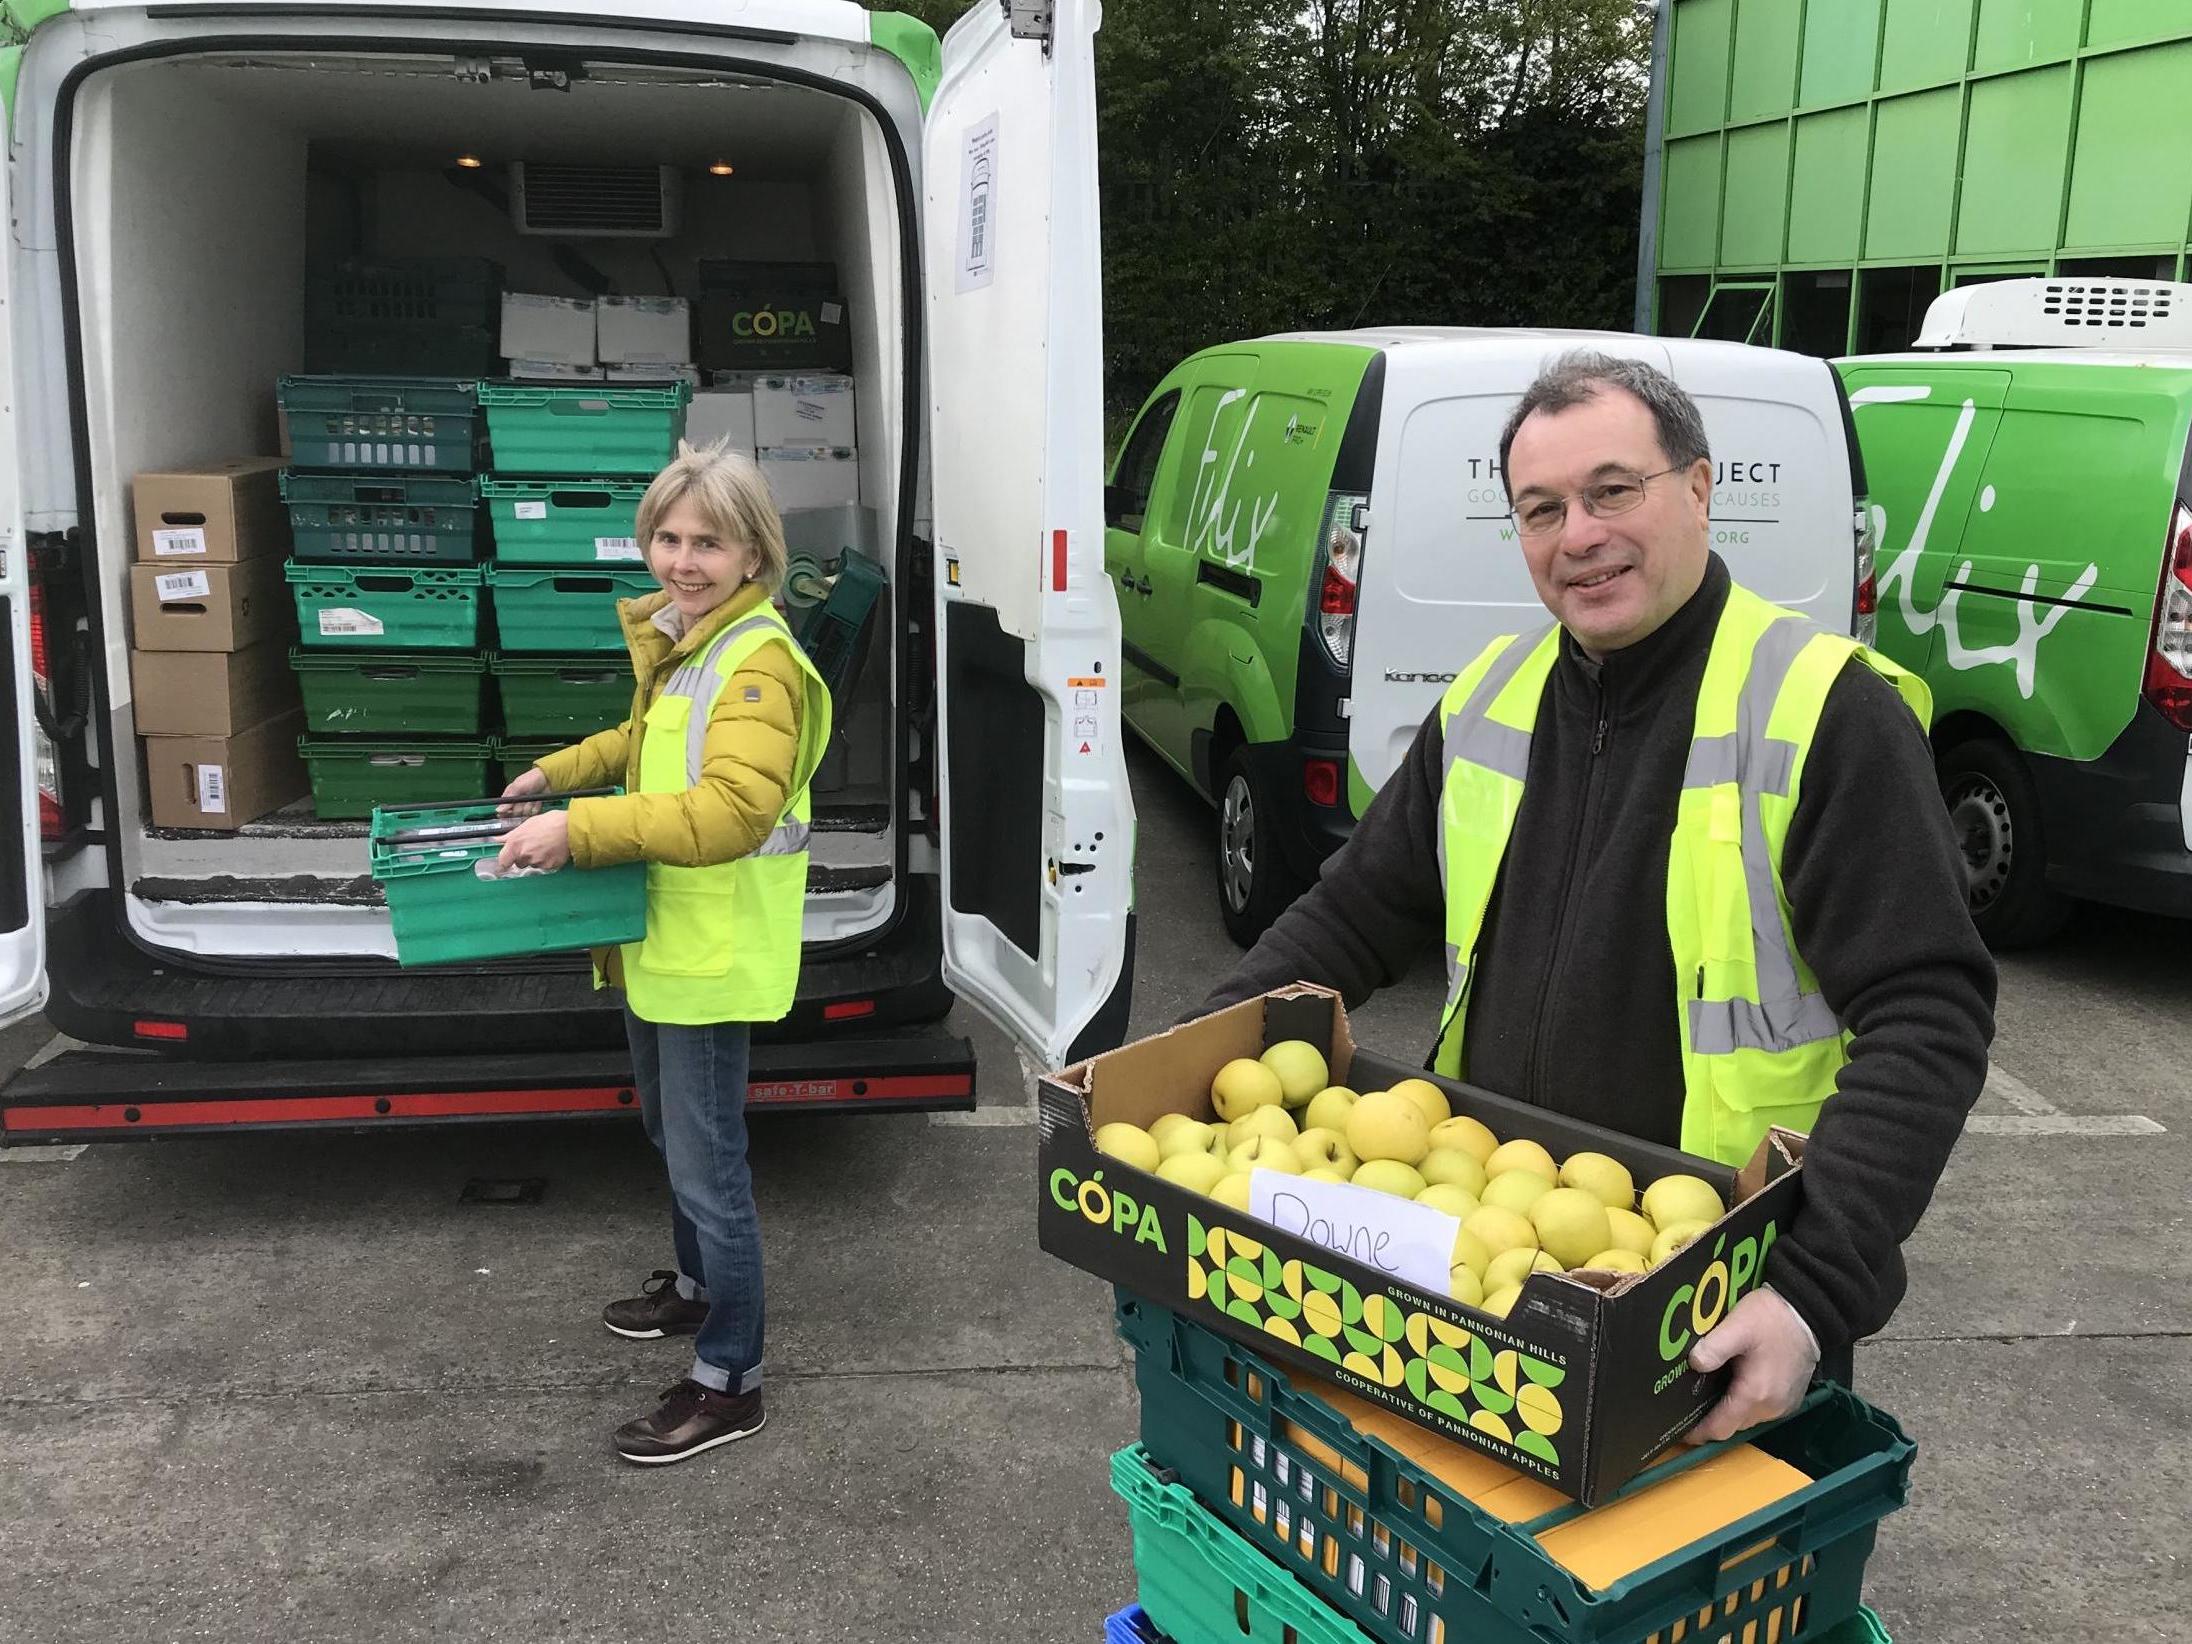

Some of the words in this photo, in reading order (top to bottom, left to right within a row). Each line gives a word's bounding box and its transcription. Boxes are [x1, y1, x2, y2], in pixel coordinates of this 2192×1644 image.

[732, 304, 816, 336] CÓPA
[1467, 459, 1501, 479] TH
[1715, 462, 1781, 485] JECT
[1712, 491, 1780, 507] CAUSES
[1384, 667, 1457, 683] Kango
[754, 1083, 833, 1098] safe-T-bar
[1049, 1167, 1168, 1254] CÓPA
[1272, 1192, 1399, 1271] Downe
[1387, 1285, 1431, 1312] GROWN
[1434, 1304, 1448, 1318] IN
[1450, 1311, 1526, 1350] PANNONIAN
[1529, 1342, 1568, 1366] HILLS
[1335, 1369, 1415, 1413] COOPERATIVE
[1418, 1408, 1434, 1421] OF
[1437, 1416, 1509, 1457] PANNONIAN
[1511, 1452, 1560, 1481] APPLES
